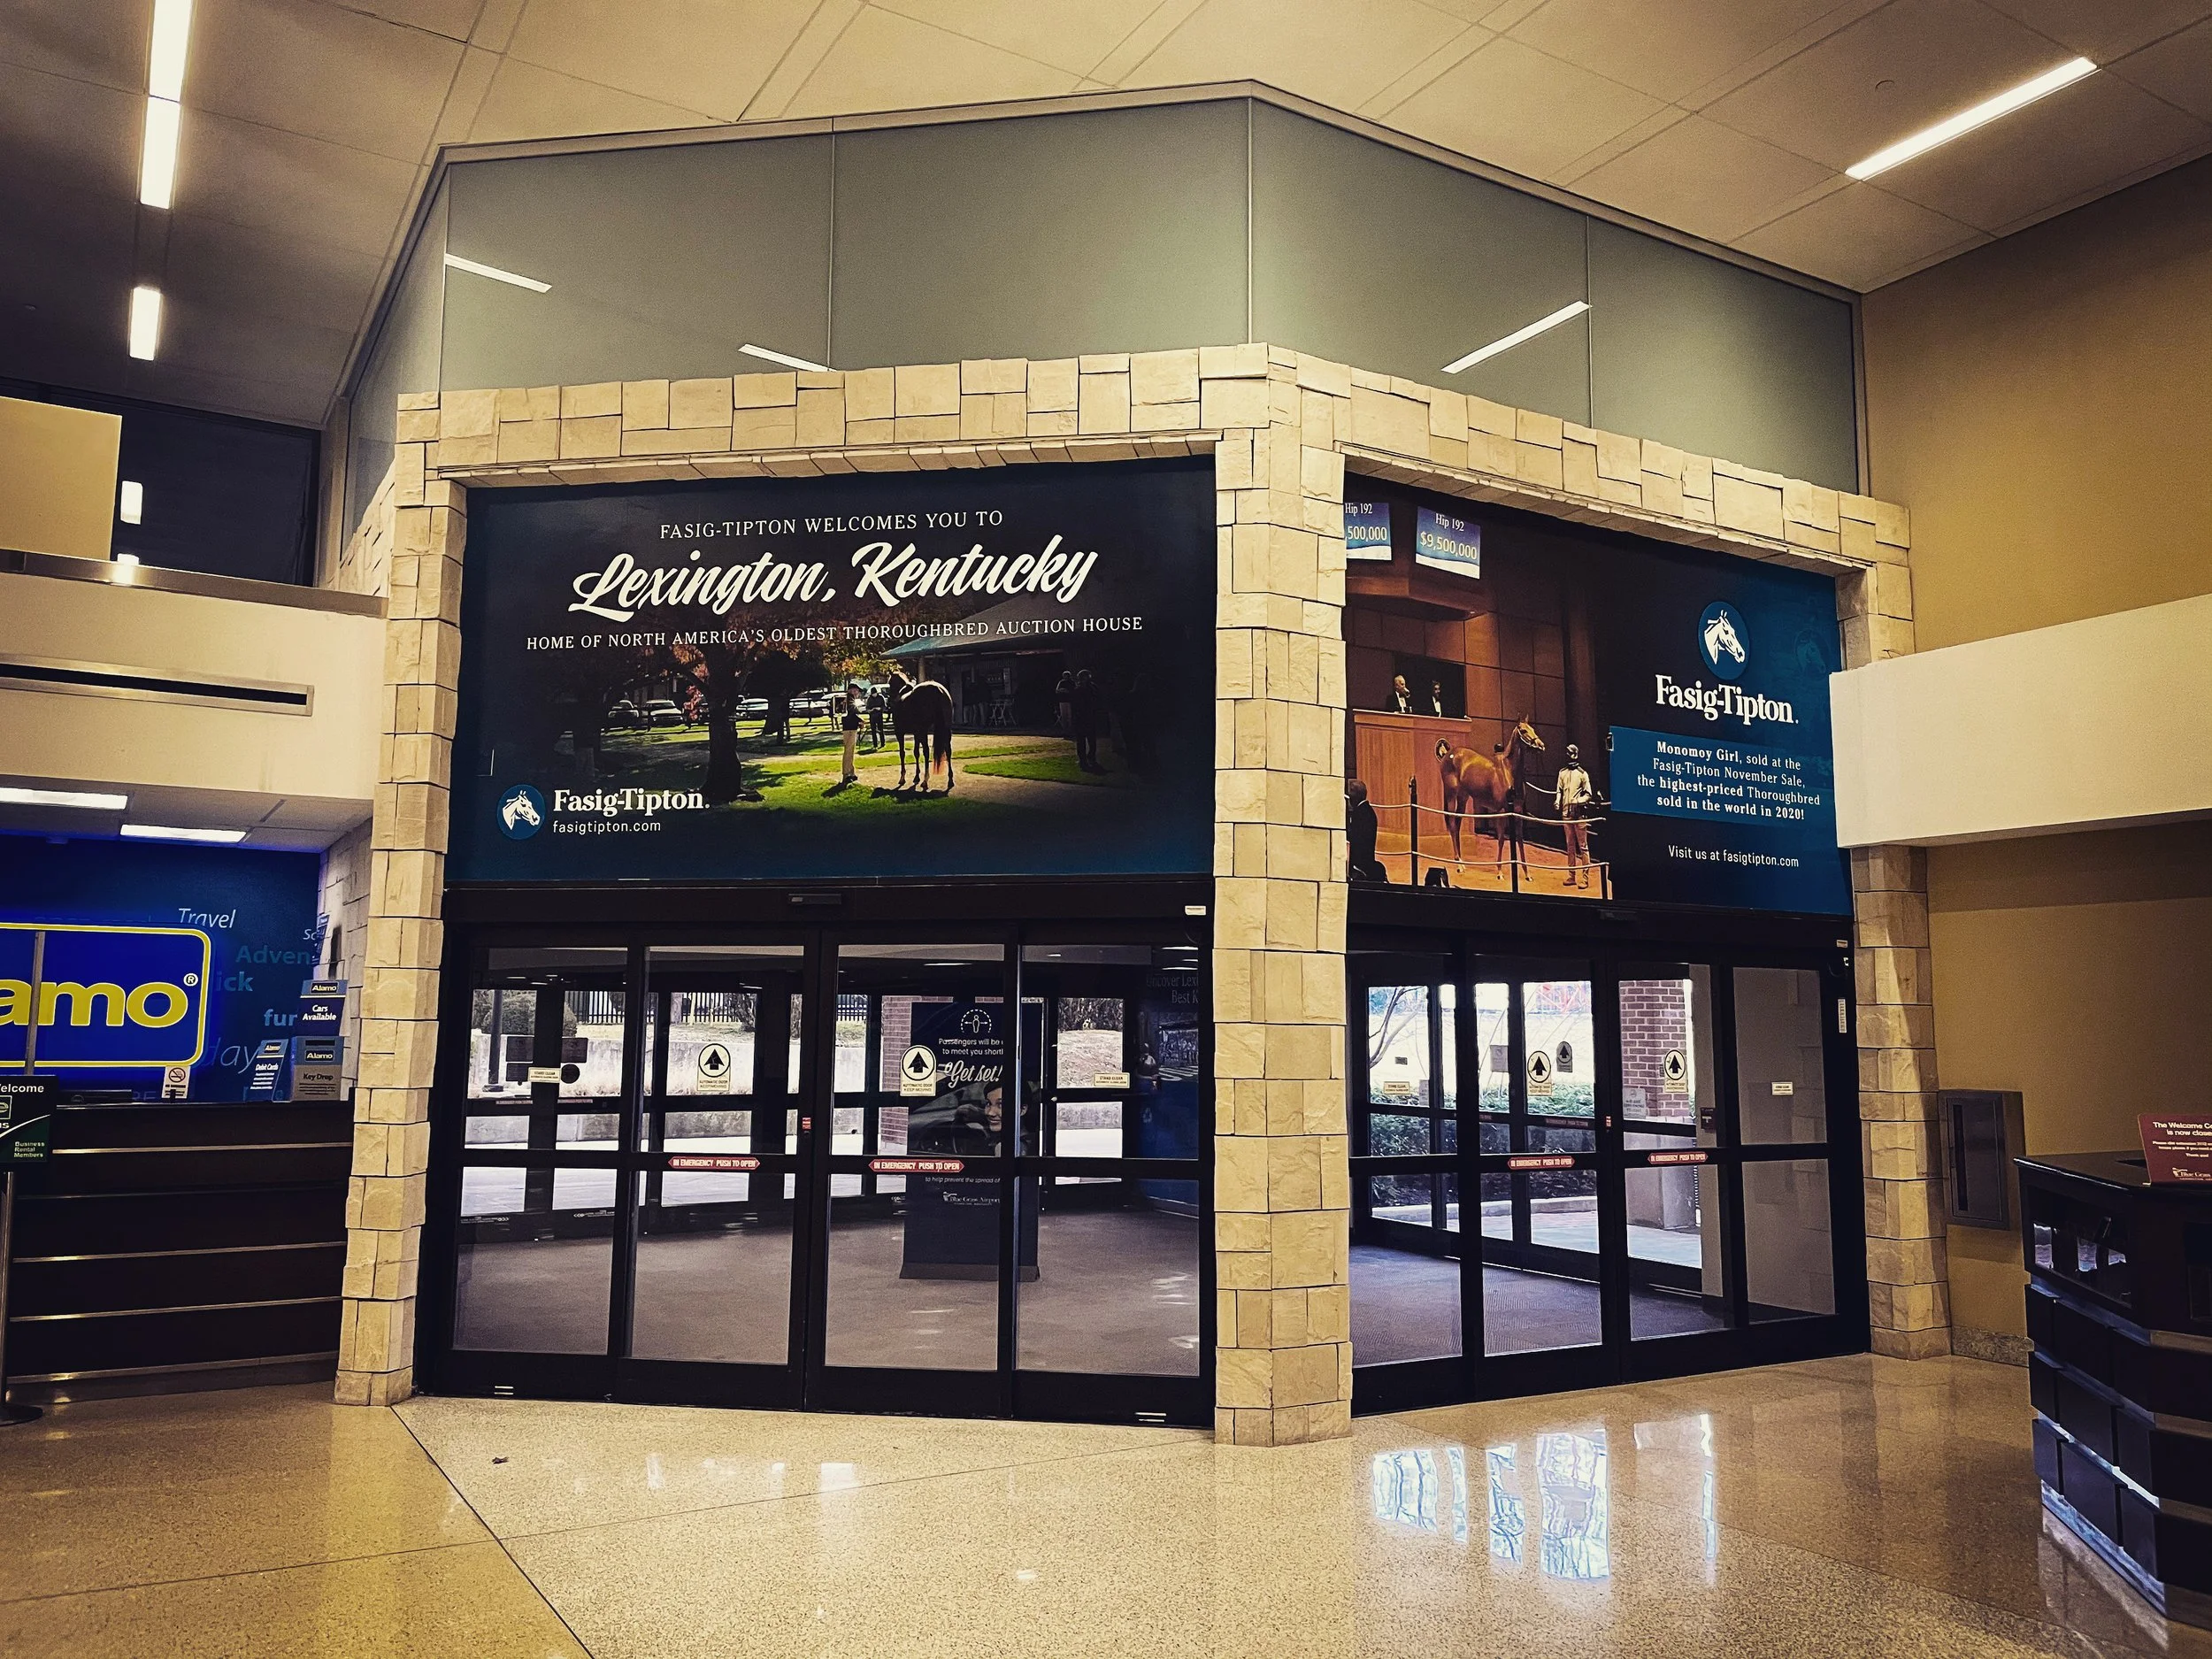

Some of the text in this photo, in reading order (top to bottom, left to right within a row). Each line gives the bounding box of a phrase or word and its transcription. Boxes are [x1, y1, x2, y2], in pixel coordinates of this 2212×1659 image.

[1345, 503, 1372, 516] Hip 192
[1435, 512, 1464, 532] Hip 192
[660, 510, 1003, 539] FASIG-TIPTON WELCOMES YOU TO
[1420, 531, 1478, 560] $9,500,000
[568, 534, 1099, 623] Lexington, Kentucky
[526, 617, 1142, 650] HOME OF NORTH AMERICA'S OLDEST THOROUGHBRED AUCTION HOUSE
[1657, 741, 1801, 771] Monomoy Girl, sold at the
[1653, 758, 1805, 788] Fasig-Tipton November Sale,
[1637, 774, 1820, 806] the highest-priced Thoroughbred
[1656, 795, 1805, 820] sold in the world in 2020!
[553, 820, 661, 835] fasigtipton.com
[1669, 845, 1800, 867] Visit us at fasigtipton.com
[179, 908, 237, 929] Travel
[1171, 989, 1191, 1004] Best
[303, 1012, 337, 1021] Available
[946, 1060, 1003, 1088] Get set!
[0, 1084, 44, 1093] elcome
